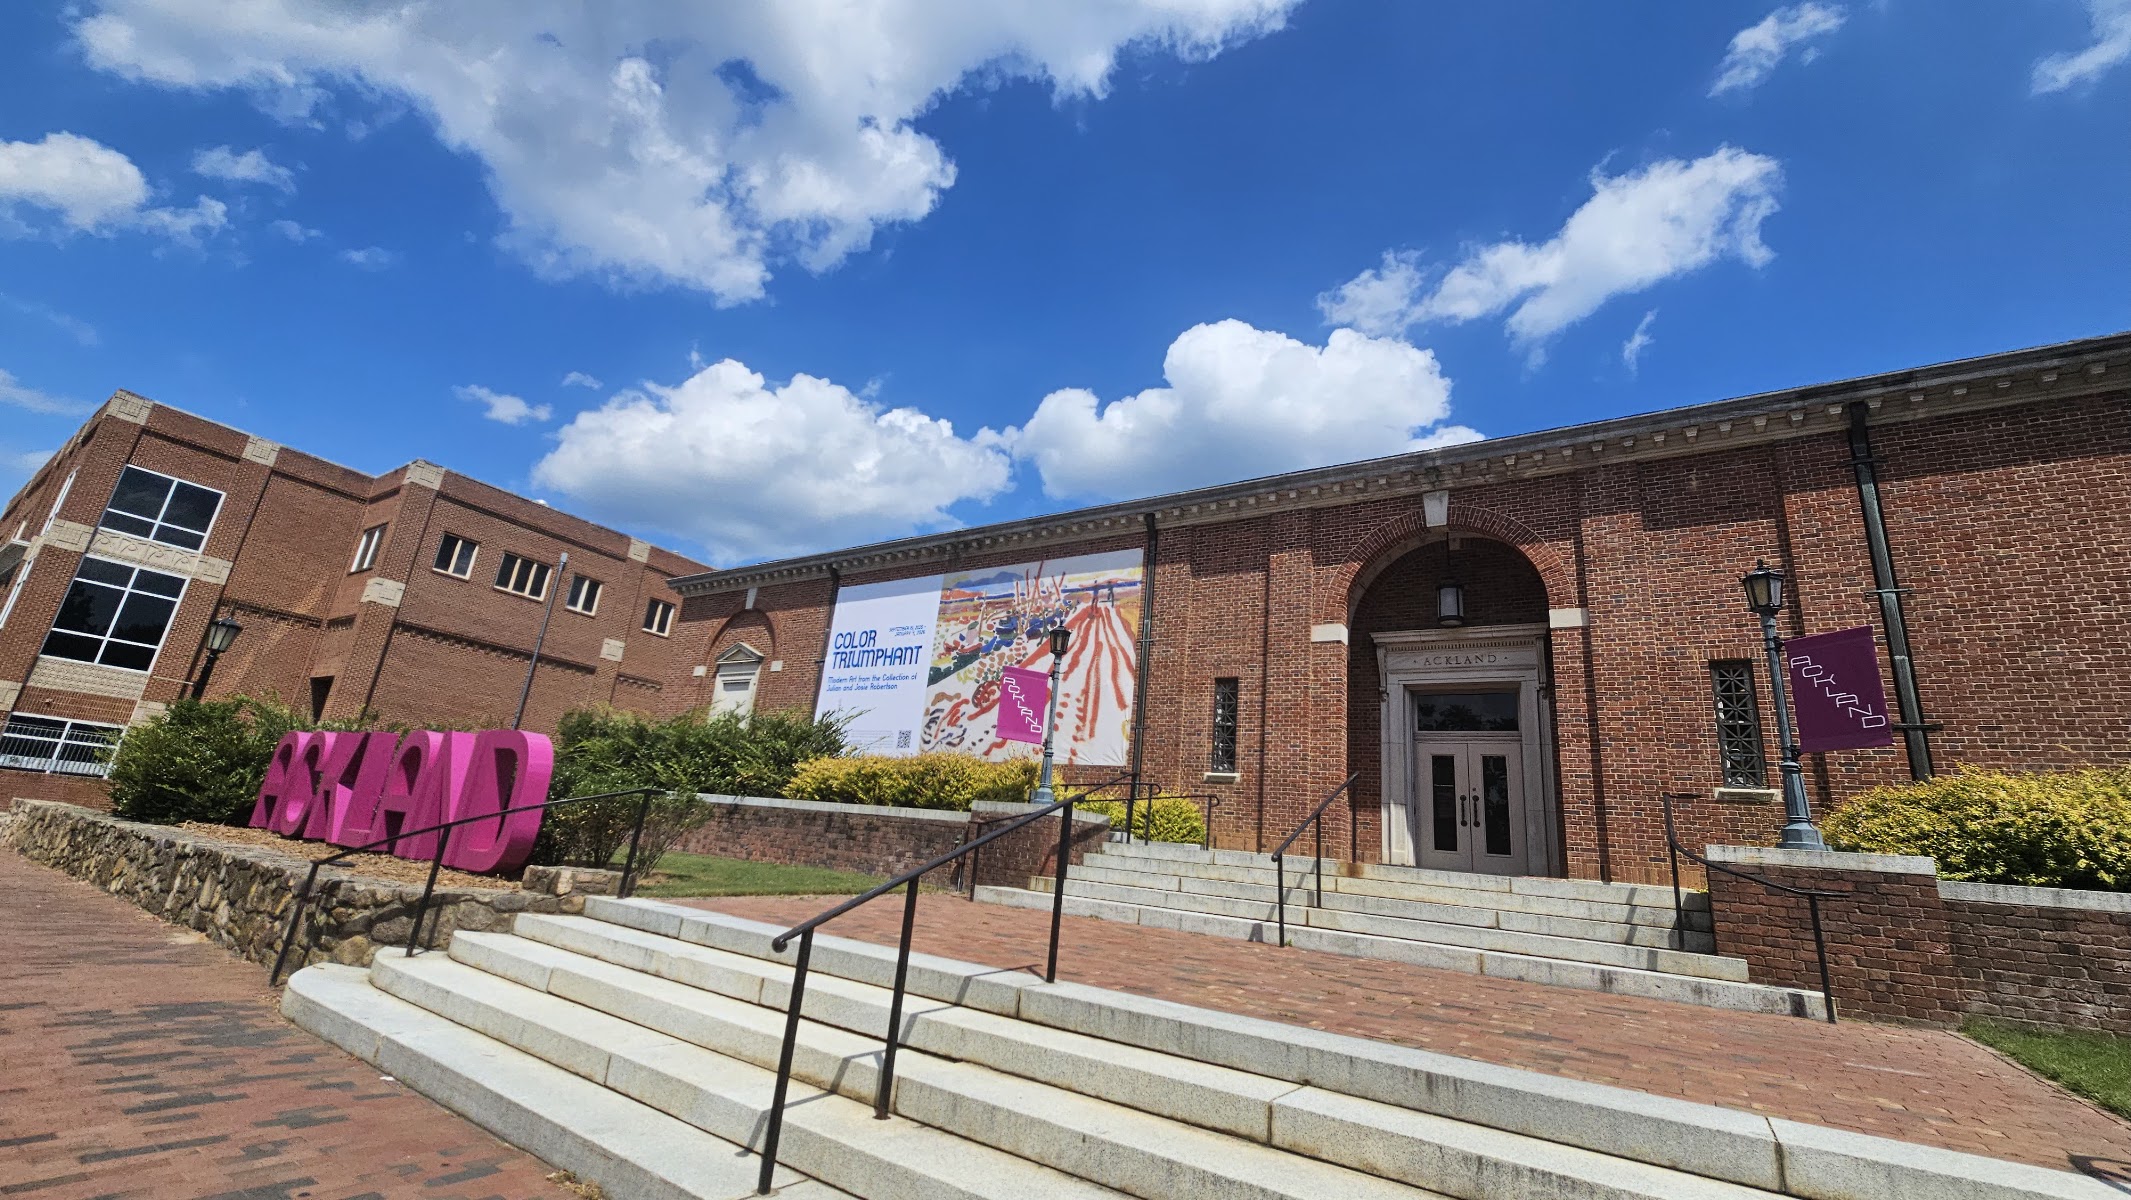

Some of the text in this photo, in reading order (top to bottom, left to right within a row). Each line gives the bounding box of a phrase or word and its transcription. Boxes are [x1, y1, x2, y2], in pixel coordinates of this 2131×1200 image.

[834, 629, 877, 650] COLOR
[832, 645, 923, 669] TRIUMPHANT
[1424, 654, 1497, 666] ACKLAND
[827, 676, 847, 684] Modern
[849, 675, 857, 683] Art
[872, 674, 881, 682] the
[882, 673, 909, 681] Collection
[911, 672, 918, 680] of
[854, 683, 868, 691] Josie
[870, 682, 898, 690] Robertson
[1790, 655, 1886, 729] ACKLAND
[1003, 677, 1043, 734] ACKLAND
[248, 729, 554, 872] ACKLAND
